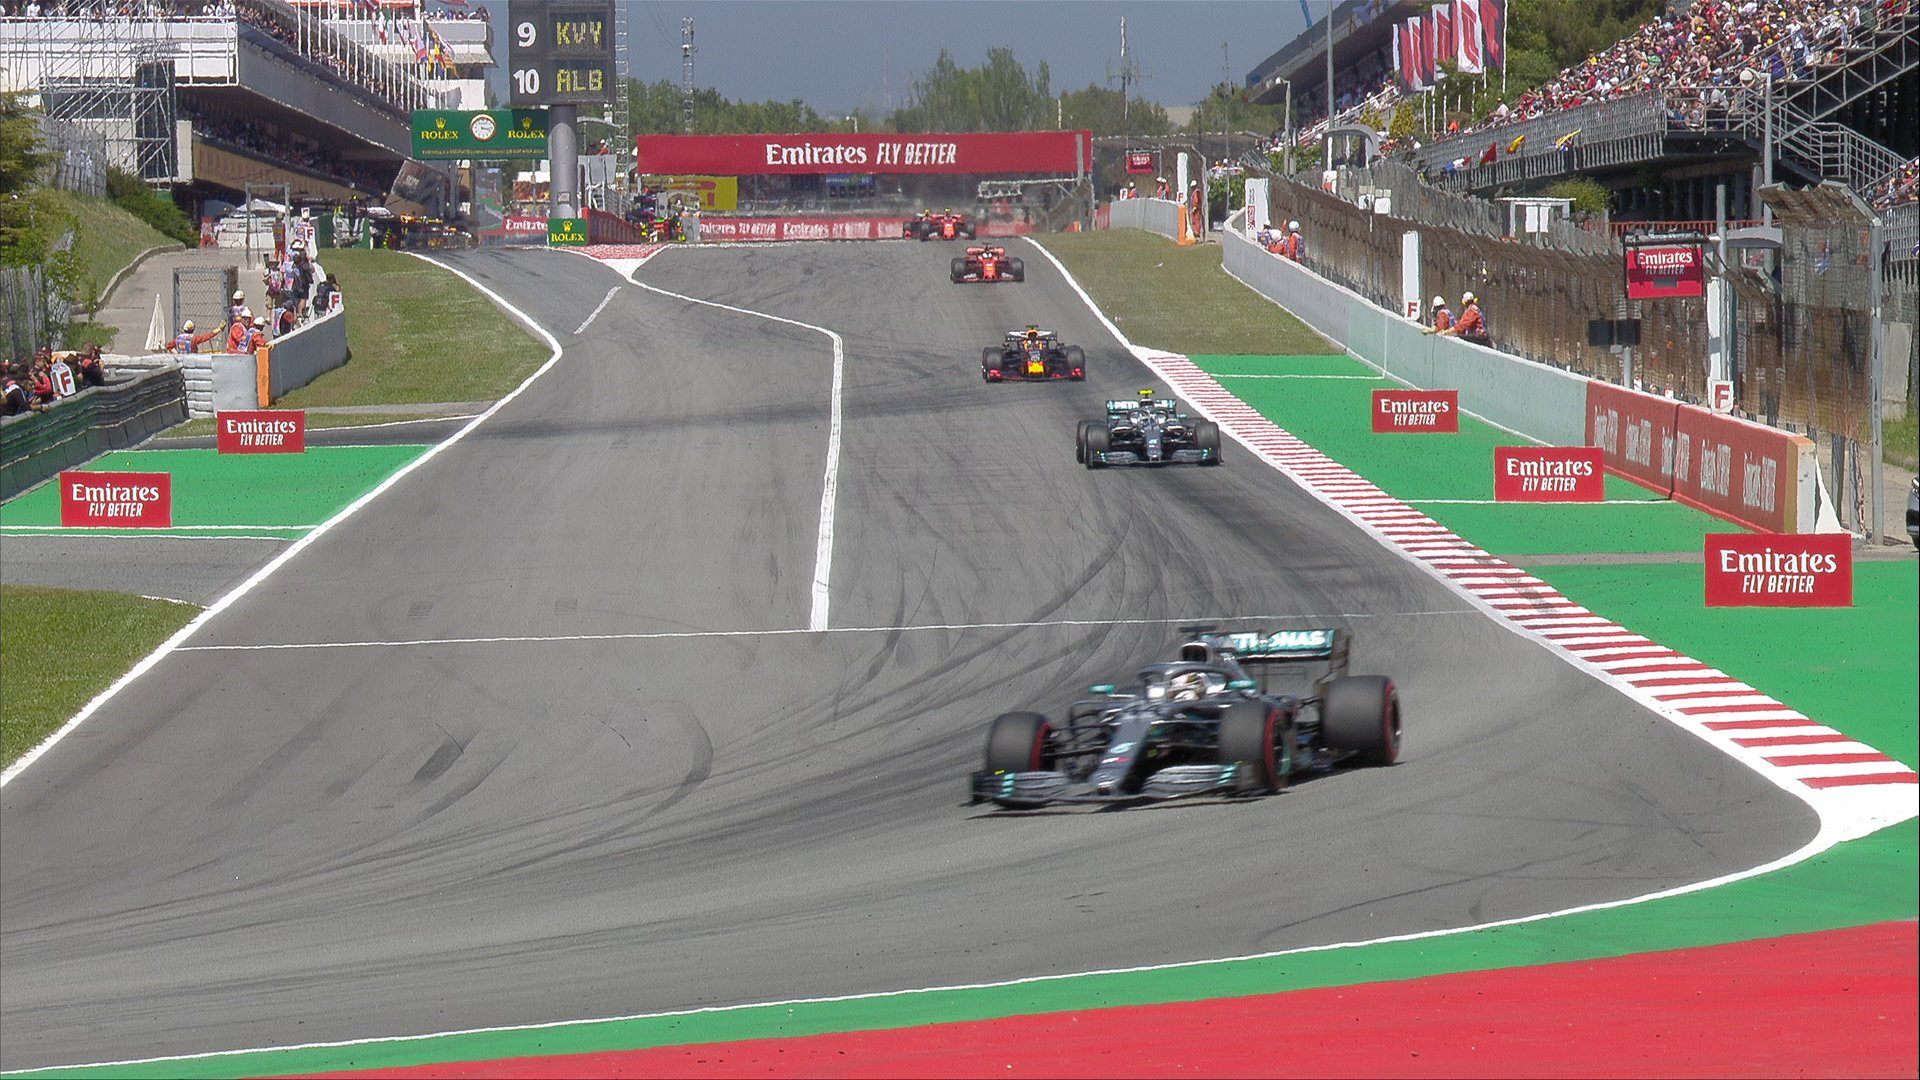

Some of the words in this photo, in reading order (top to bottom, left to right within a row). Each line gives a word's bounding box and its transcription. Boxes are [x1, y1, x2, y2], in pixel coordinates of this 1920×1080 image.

[516, 22, 537, 47] 9
[556, 21, 602, 45] KVY
[513, 69, 540, 94] 10
[556, 69, 603, 92] ALB
[421, 130, 459, 140] ROLEX
[507, 130, 545, 139] ROLEX
[766, 143, 867, 165] Emirates
[876, 143, 901, 165] FLY
[904, 142, 957, 165] BETTER
[551, 232, 585, 242] ROLEX
[1637, 251, 1693, 265] Emirates
[1658, 265, 1685, 275] BETTER
[331, 294, 340, 309] F
[1407, 302, 1418, 318] F
[60, 370, 72, 393] F
[1715, 384, 1731, 409] F
[1380, 398, 1449, 413] Emirates
[226, 418, 296, 434] Emirates
[1394, 413, 1408, 426] FLY
[1408, 413, 1437, 426] BETTER
[240, 433, 254, 446] FLY
[255, 433, 284, 446] BETTER
[1506, 456, 1593, 476] Emirates
[72, 482, 160, 502] Emirates
[1522, 477, 1539, 492] FLY
[1540, 477, 1577, 492] BETTER
[88, 502, 106, 517] FLY
[107, 502, 144, 517] BETTER
[1720, 547, 1837, 573] Emirates
[1742, 574, 1765, 593] FLY
[1767, 574, 1815, 593] BETTER
